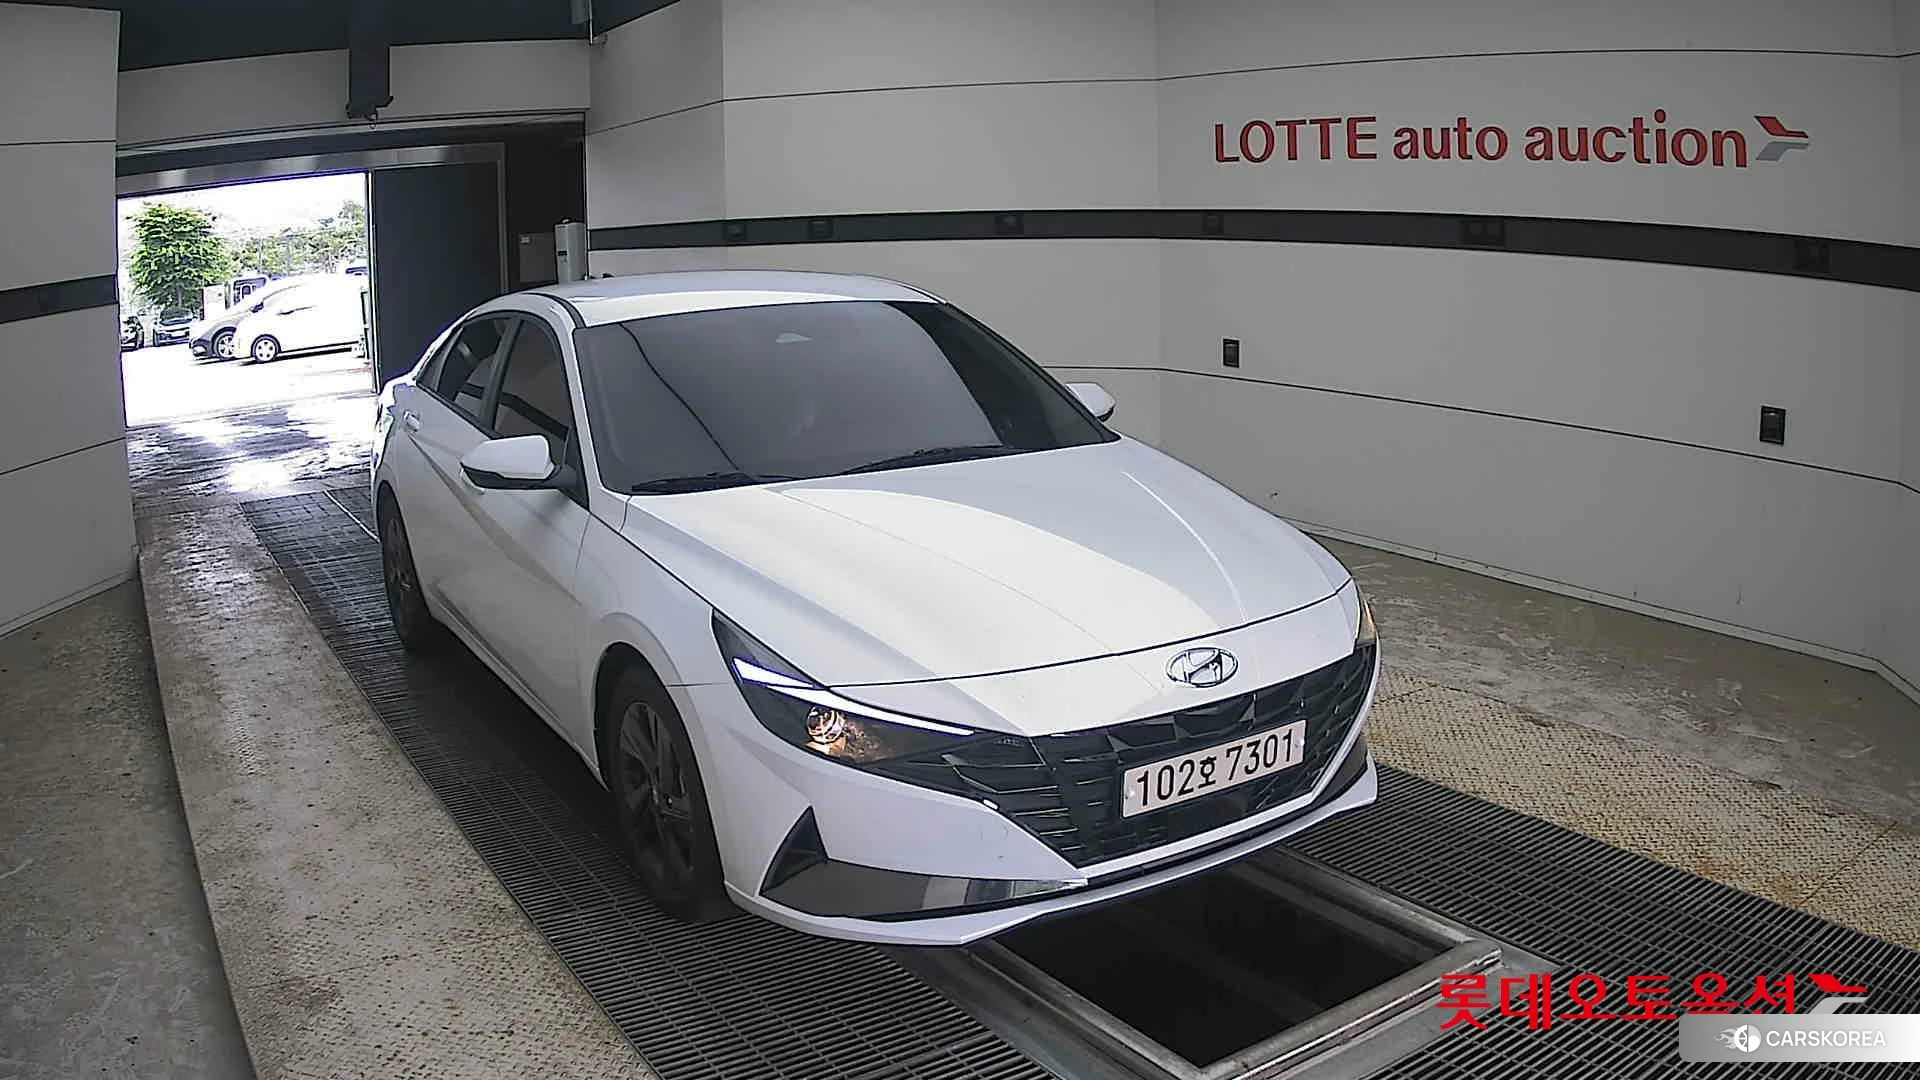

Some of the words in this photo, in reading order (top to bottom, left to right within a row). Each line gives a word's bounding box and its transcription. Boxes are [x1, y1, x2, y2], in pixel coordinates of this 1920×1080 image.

[1215, 116, 1377, 163] LOTTE
[1392, 116, 1510, 162] auto
[1523, 109, 1748, 168] auction
[1136, 756, 1217, 807] 102호
[1225, 728, 1293, 781] 7301
